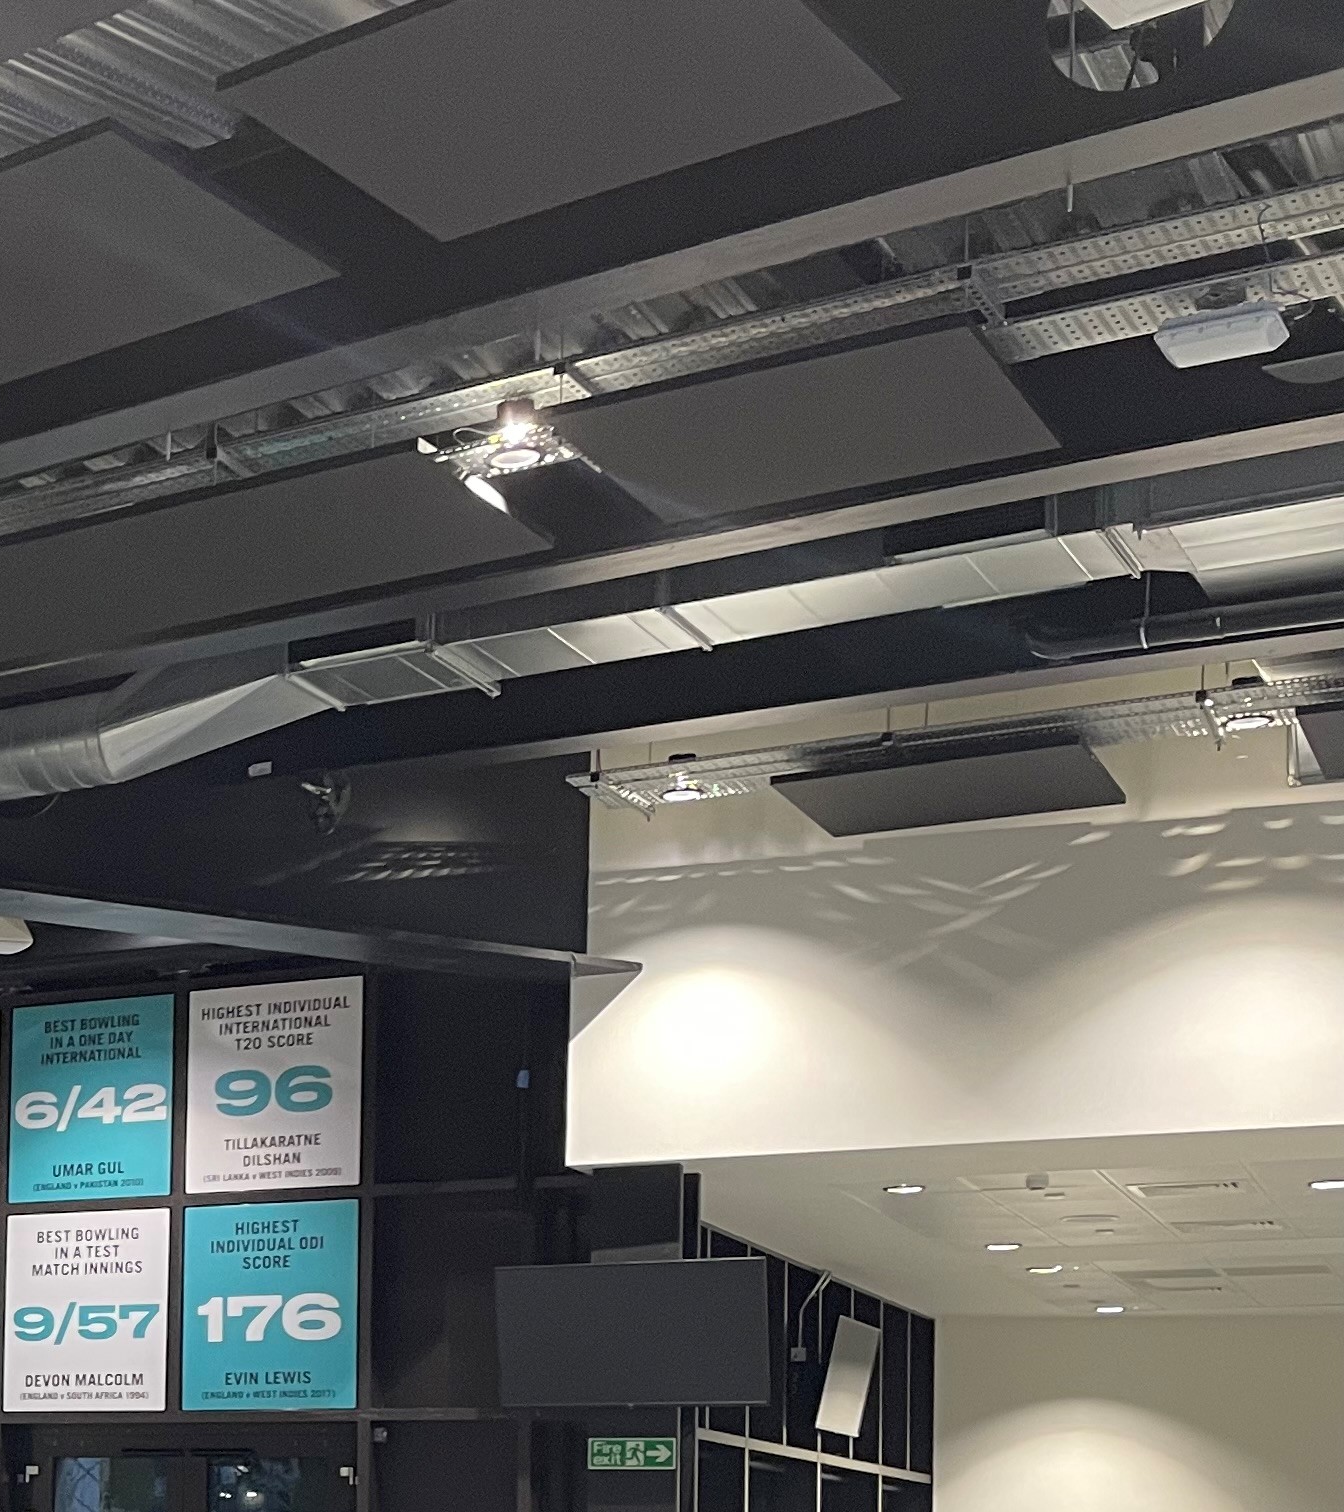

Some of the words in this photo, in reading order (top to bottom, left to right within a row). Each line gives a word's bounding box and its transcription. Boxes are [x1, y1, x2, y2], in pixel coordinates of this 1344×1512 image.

[201, 1004, 262, 1021] HIGHEST
[268, 996, 350, 1015] INDIVIDUAL
[44, 1019, 76, 1033] BEST
[80, 1014, 140, 1031] BOWLING
[219, 1015, 331, 1036] INTERNATIONAL
[50, 1037, 63, 1049] IN
[67, 1036, 75, 1047] A
[79, 1033, 104, 1047] ONE
[109, 1031, 134, 1044] DAY
[236, 1038, 261, 1051] T20
[267, 1032, 314, 1048] SCORE
[41, 1047, 142, 1065] INTERNATIONAL
[215, 1064, 333, 1117] 96
[15, 1084, 167, 1132] 6/42
[224, 1133, 321, 1150] TILLAKARATNE
[243, 1152, 301, 1167] DILSHAN
[52, 1163, 93, 1177] UMAR
[98, 1162, 124, 1175] GUL
[223, 1172, 249, 1181] LANKA
[259, 1170, 282, 1179] WEST
[285, 1169, 312, 1178] INDIES
[33, 1182, 72, 1192] (ENGLAND
[80, 1179, 118, 1189] PAKISTAN
[235, 1219, 299, 1235] HIGHEST
[37, 1230, 71, 1243] BEST
[76, 1228, 140, 1242] BOWLING
[55, 1247, 68, 1259] IN
[73, 1246, 81, 1258] A
[87, 1245, 119, 1257] TEST
[211, 1238, 295, 1254] INDIVIDUAL
[300, 1236, 324, 1249] ODI
[32, 1264, 79, 1276] MATCH
[85, 1261, 142, 1275] INNINGS
[243, 1255, 291, 1270] SCORE
[13, 1302, 160, 1345] 9/57
[198, 1293, 342, 1342] 176
[25, 1374, 70, 1387] DEVON
[75, 1373, 144, 1386] MALCOLM
[225, 1372, 258, 1385] EVIN
[265, 1371, 312, 1384] LEWIS
[20, 1392, 58, 1401] (ENGLAND
[66, 1392, 93, 1400] SOUTH
[202, 1390, 243, 1400] (ENGLAND
[253, 1390, 276, 1398] WEST
[593, 1441, 621, 1453] Fire
[593, 1454, 621, 1465] exit
